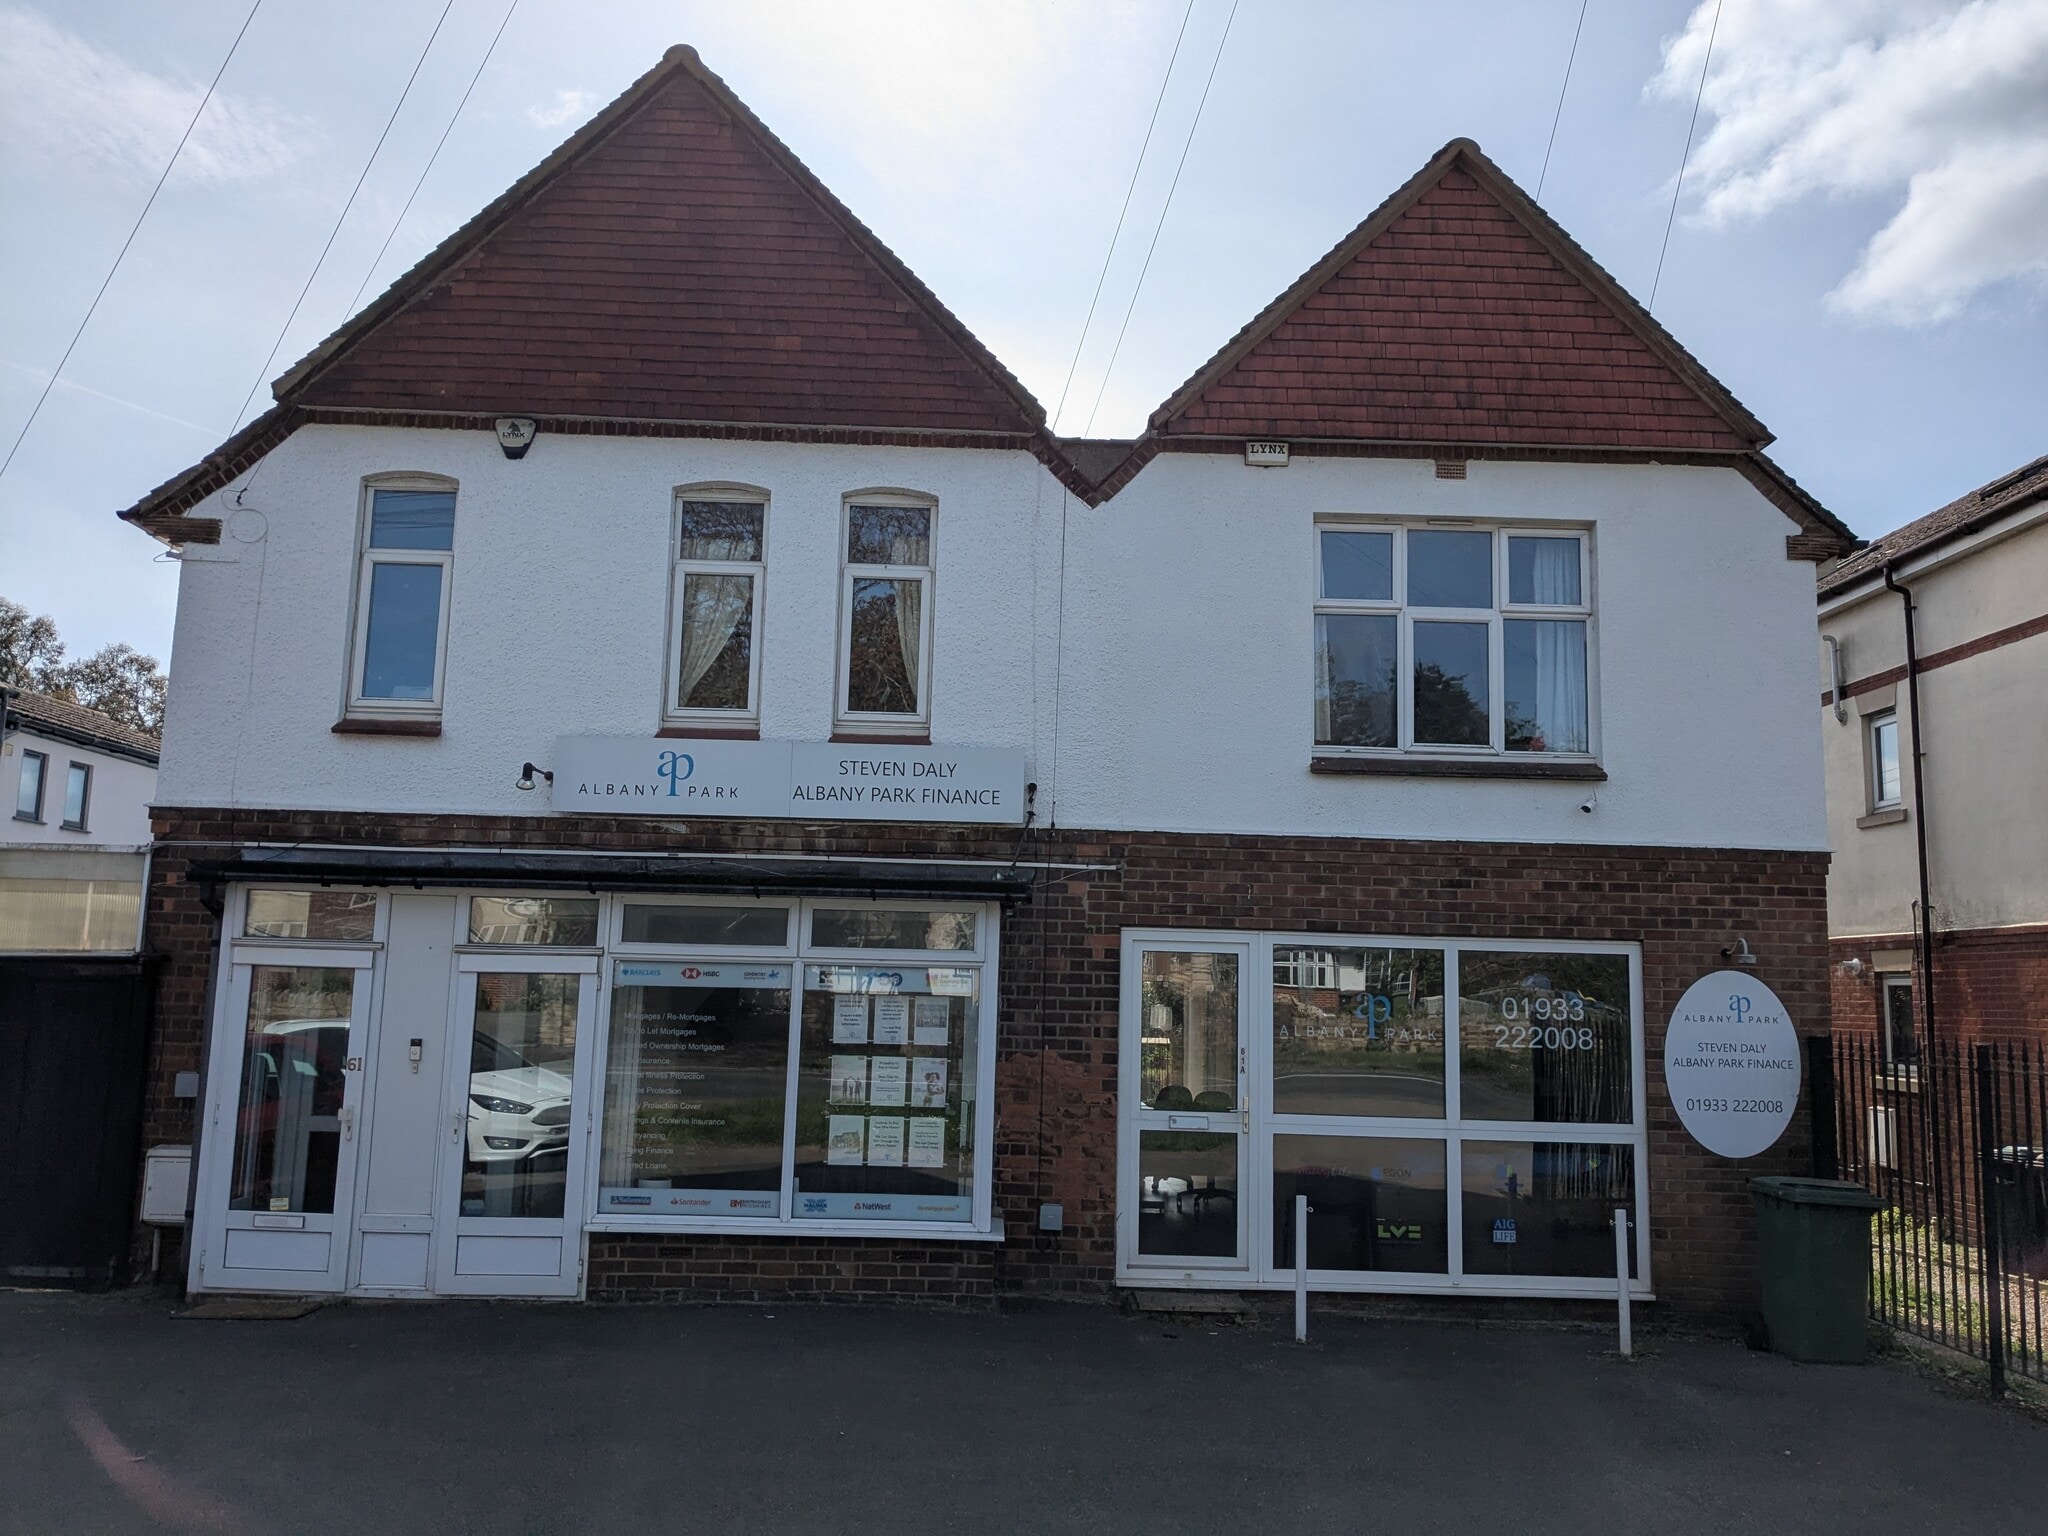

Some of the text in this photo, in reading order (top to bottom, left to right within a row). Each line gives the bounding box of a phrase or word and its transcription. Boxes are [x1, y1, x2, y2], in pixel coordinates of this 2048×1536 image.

[502, 431, 525, 440] LYNX
[1250, 444, 1286, 454] LYNX
[838, 759, 957, 779] STEVEN DALY
[578, 782, 739, 799] ALBANY PARK
[792, 784, 1001, 806] ALBANY PARK FINANCE
[629, 969, 661, 977] BARCLAYS
[1501, 996, 1585, 1022] 01933
[666, 1013, 716, 1022] Re-Mortgages
[1684, 1014, 1779, 1024] ALBANY PARK
[647, 1027, 658, 1035] Let
[660, 1028, 697, 1036] Mortgages
[1279, 1025, 1438, 1041] ALBANY PARK
[1494, 1026, 1594, 1051] 222008
[649, 1042, 686, 1050] Ownership
[688, 1043, 725, 1052] Mortgages
[1697, 1042, 1766, 1053] STEVEN DALY
[346, 1057, 362, 1072] 61
[1673, 1057, 1794, 1070] ALBANY PARK FINANCE
[646, 1086, 681, 1094] Protection
[643, 1101, 678, 1109] Protection
[680, 1102, 701, 1110] Cover
[1686, 1098, 1783, 1113] 01933 222008
[658, 1117, 690, 1125] Contents
[691, 1117, 726, 1126] Insurance
[862, 1202, 891, 1210] NatWest
[1494, 1219, 1515, 1229] AIG
[1494, 1231, 1516, 1241] LIFE
